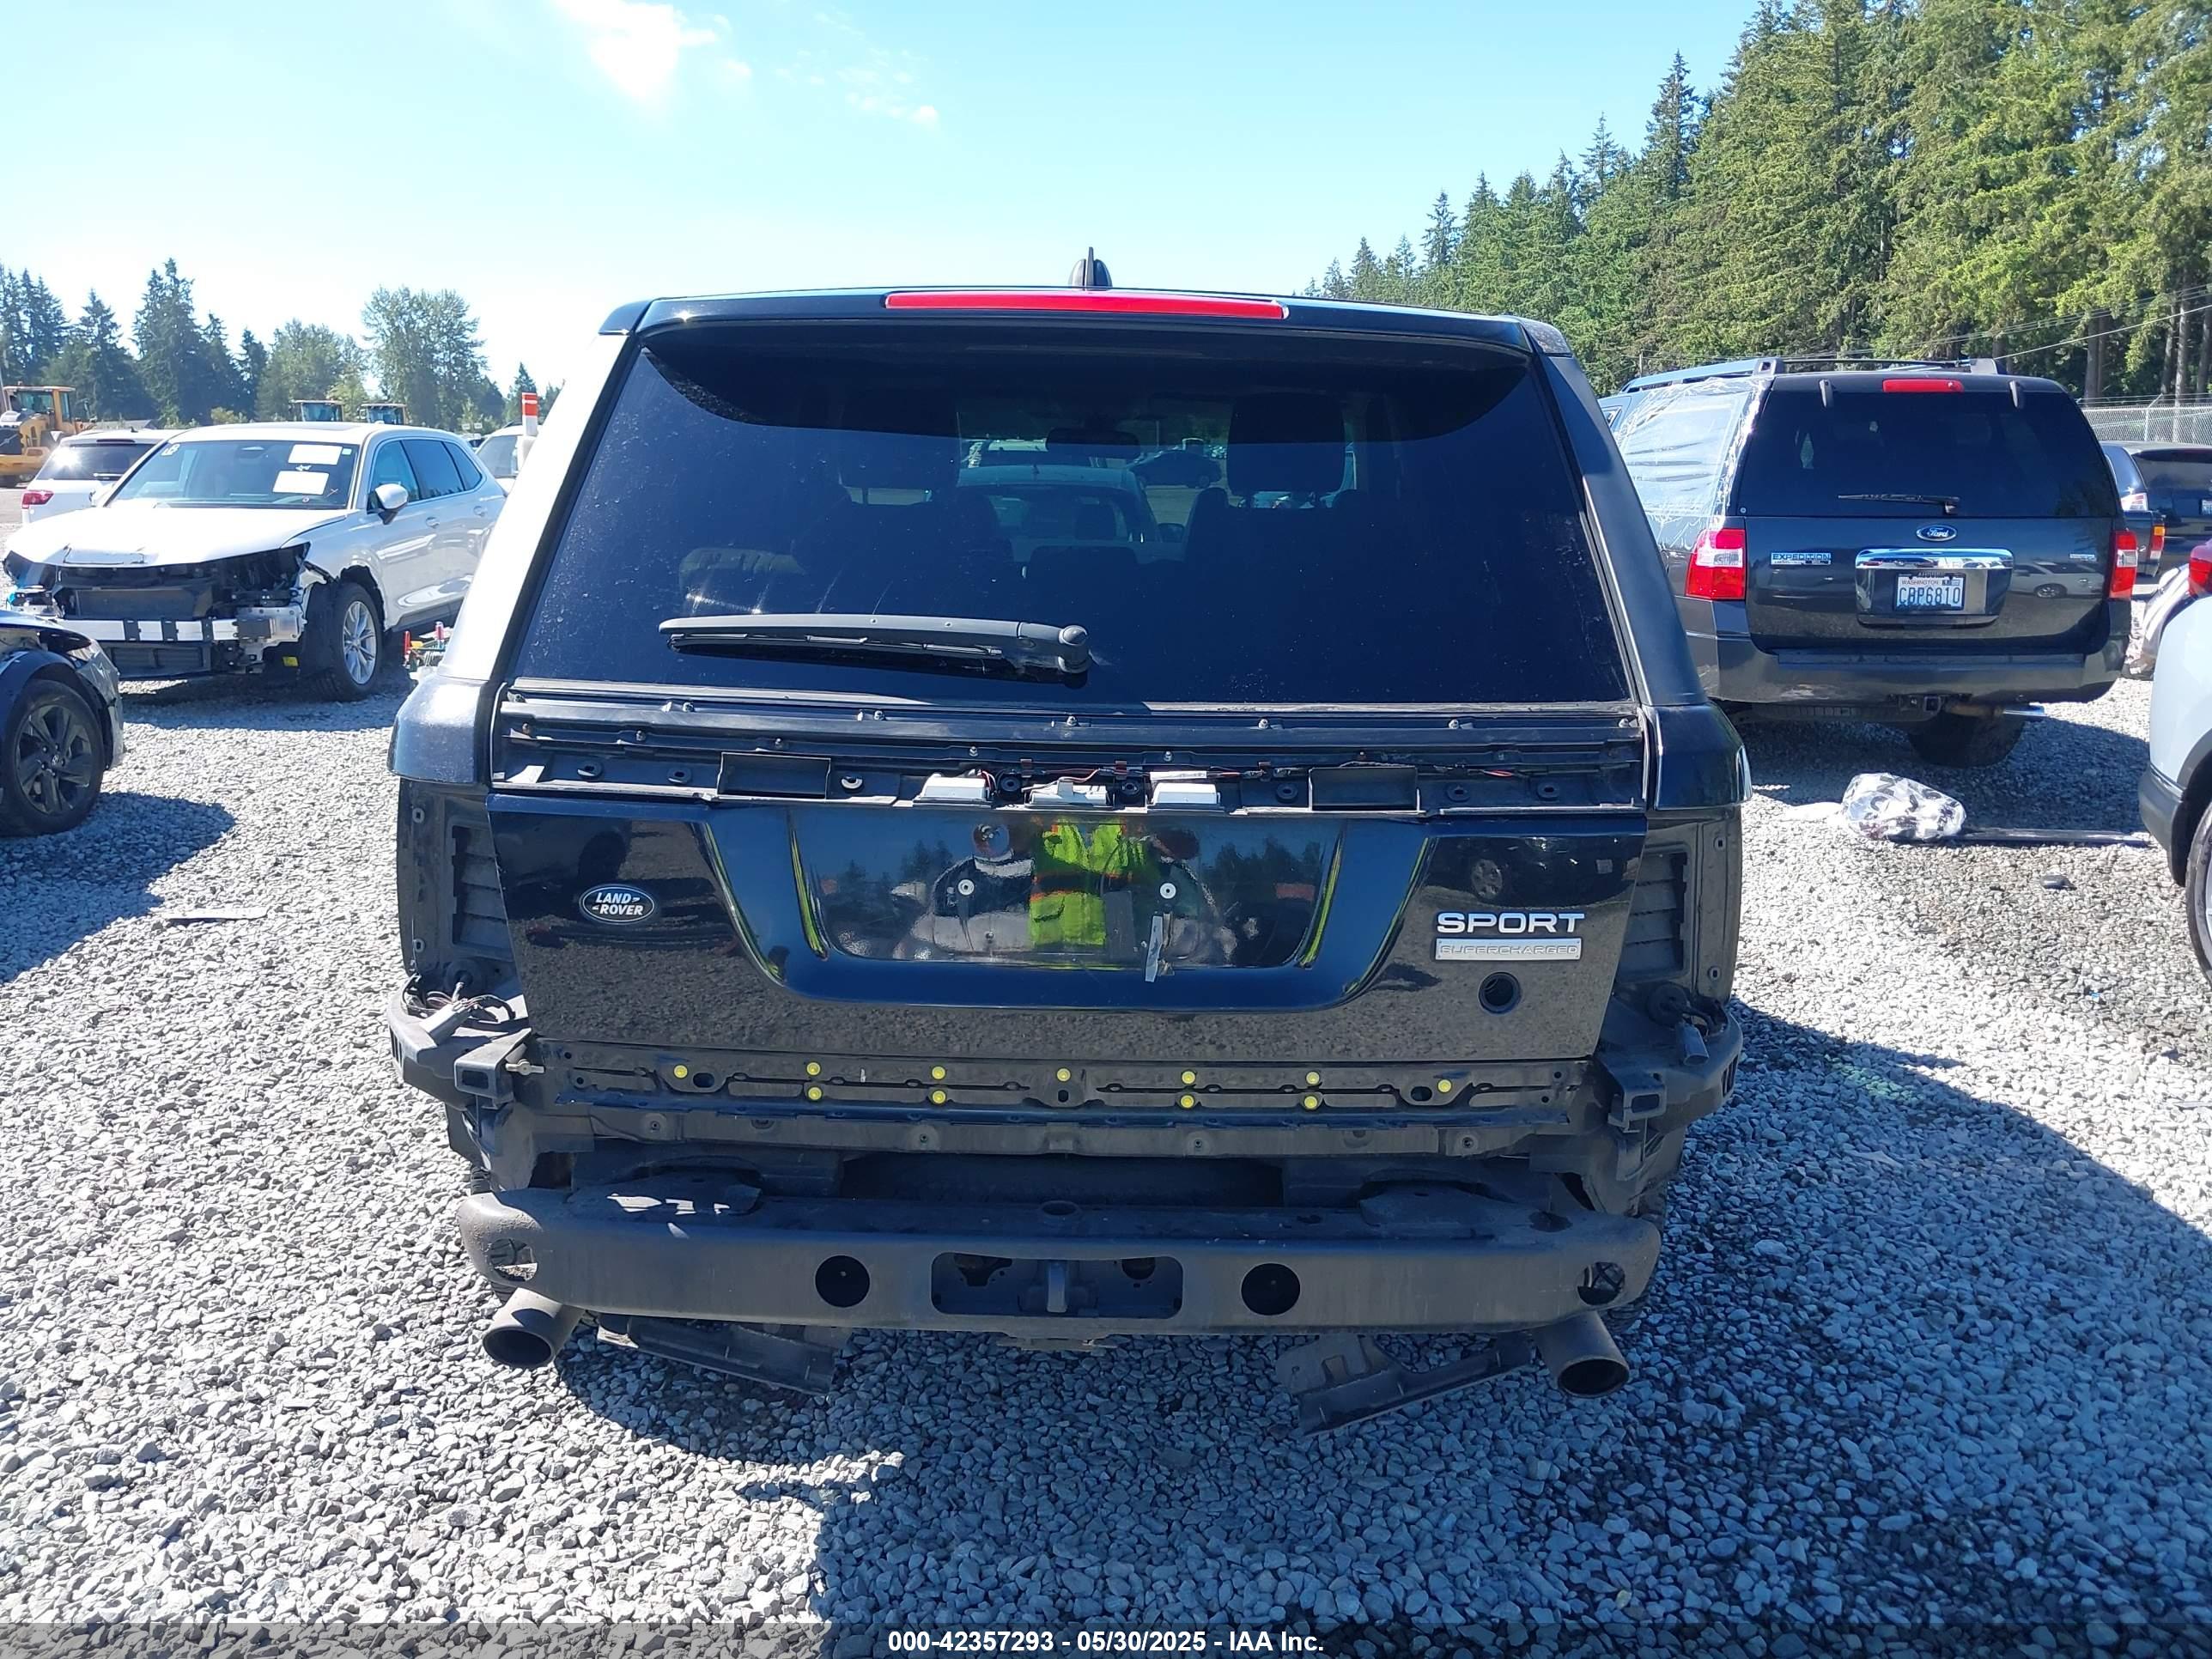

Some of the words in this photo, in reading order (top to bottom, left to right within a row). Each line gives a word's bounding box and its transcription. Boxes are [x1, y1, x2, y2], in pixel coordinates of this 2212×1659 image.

[1926, 527, 1950, 538] Ford
[595, 892, 632, 904] LAND
[599, 904, 644, 915] ROVER
[1437, 912, 1585, 933] SPORT
[1439, 945, 1578, 955] SUPERCHARGED
